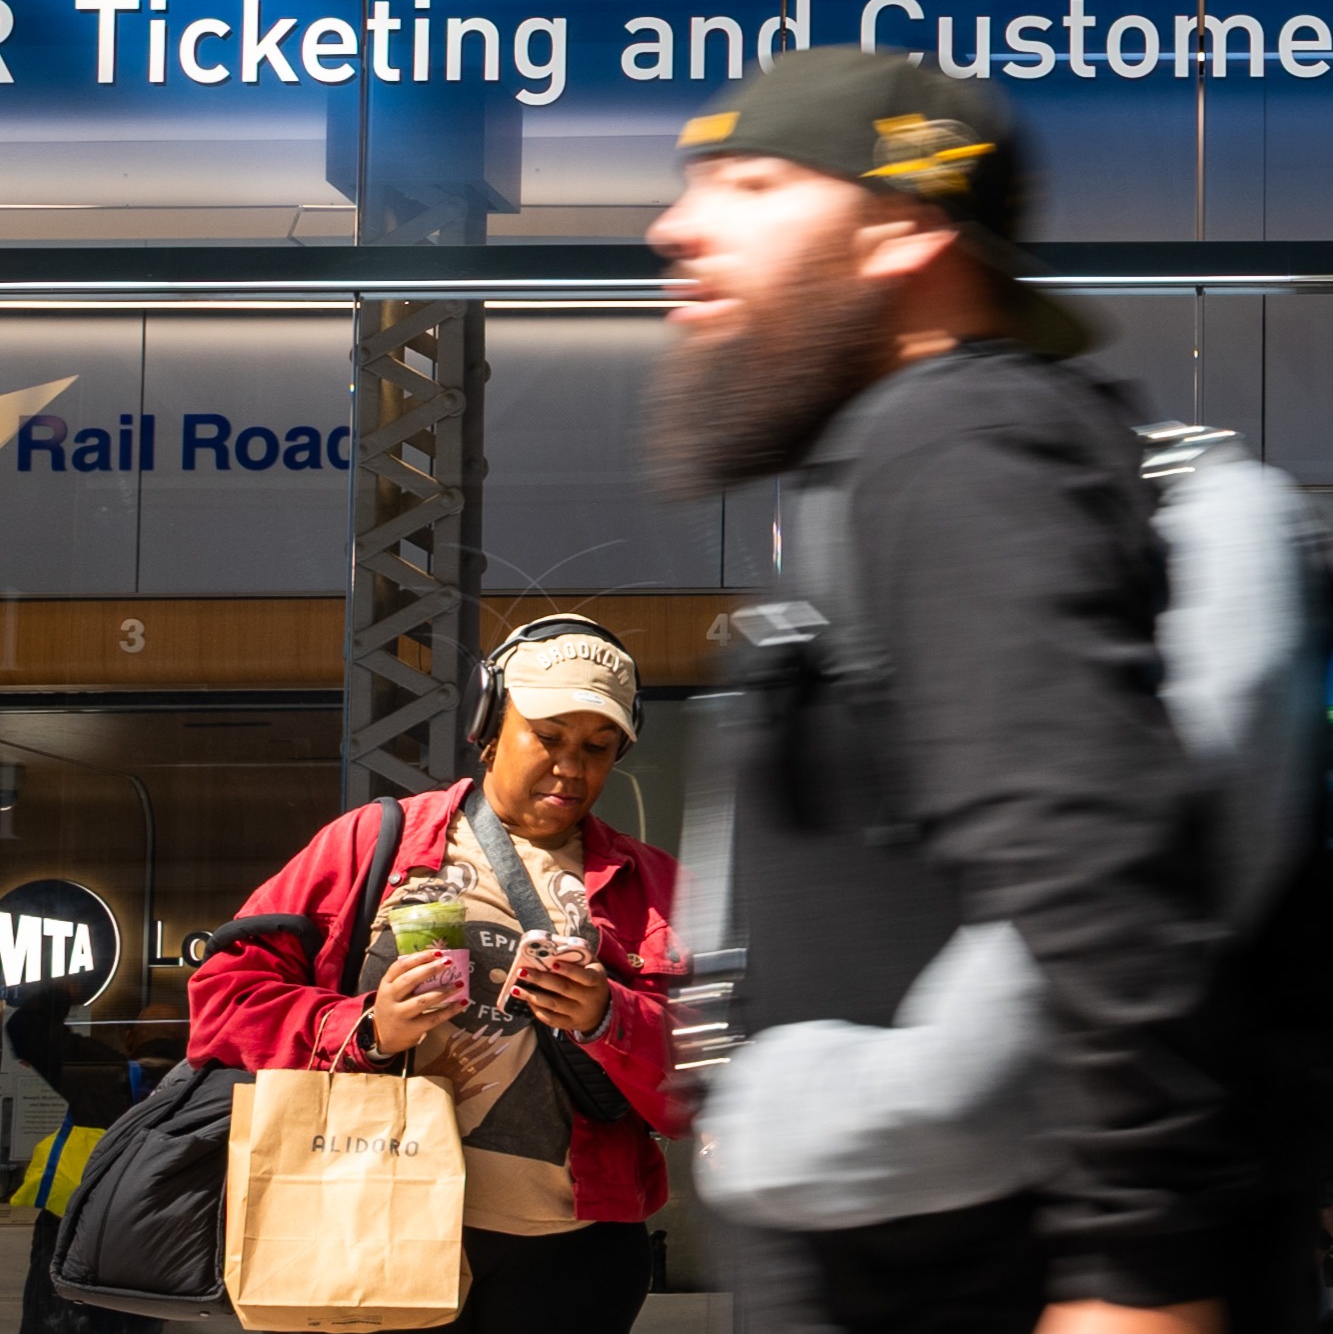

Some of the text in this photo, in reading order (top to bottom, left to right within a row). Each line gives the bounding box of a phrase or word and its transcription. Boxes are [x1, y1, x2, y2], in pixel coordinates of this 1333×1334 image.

[18, 414, 156, 472] Rail
[118, 617, 146, 654] 3
[705, 612, 733, 647] 4
[540, 640, 631, 686] BROOKLYN
[0, 911, 214, 988] MTA Lo
[479, 930, 517, 953] EPI
[311, 1134, 420, 1158] ALIDORO
